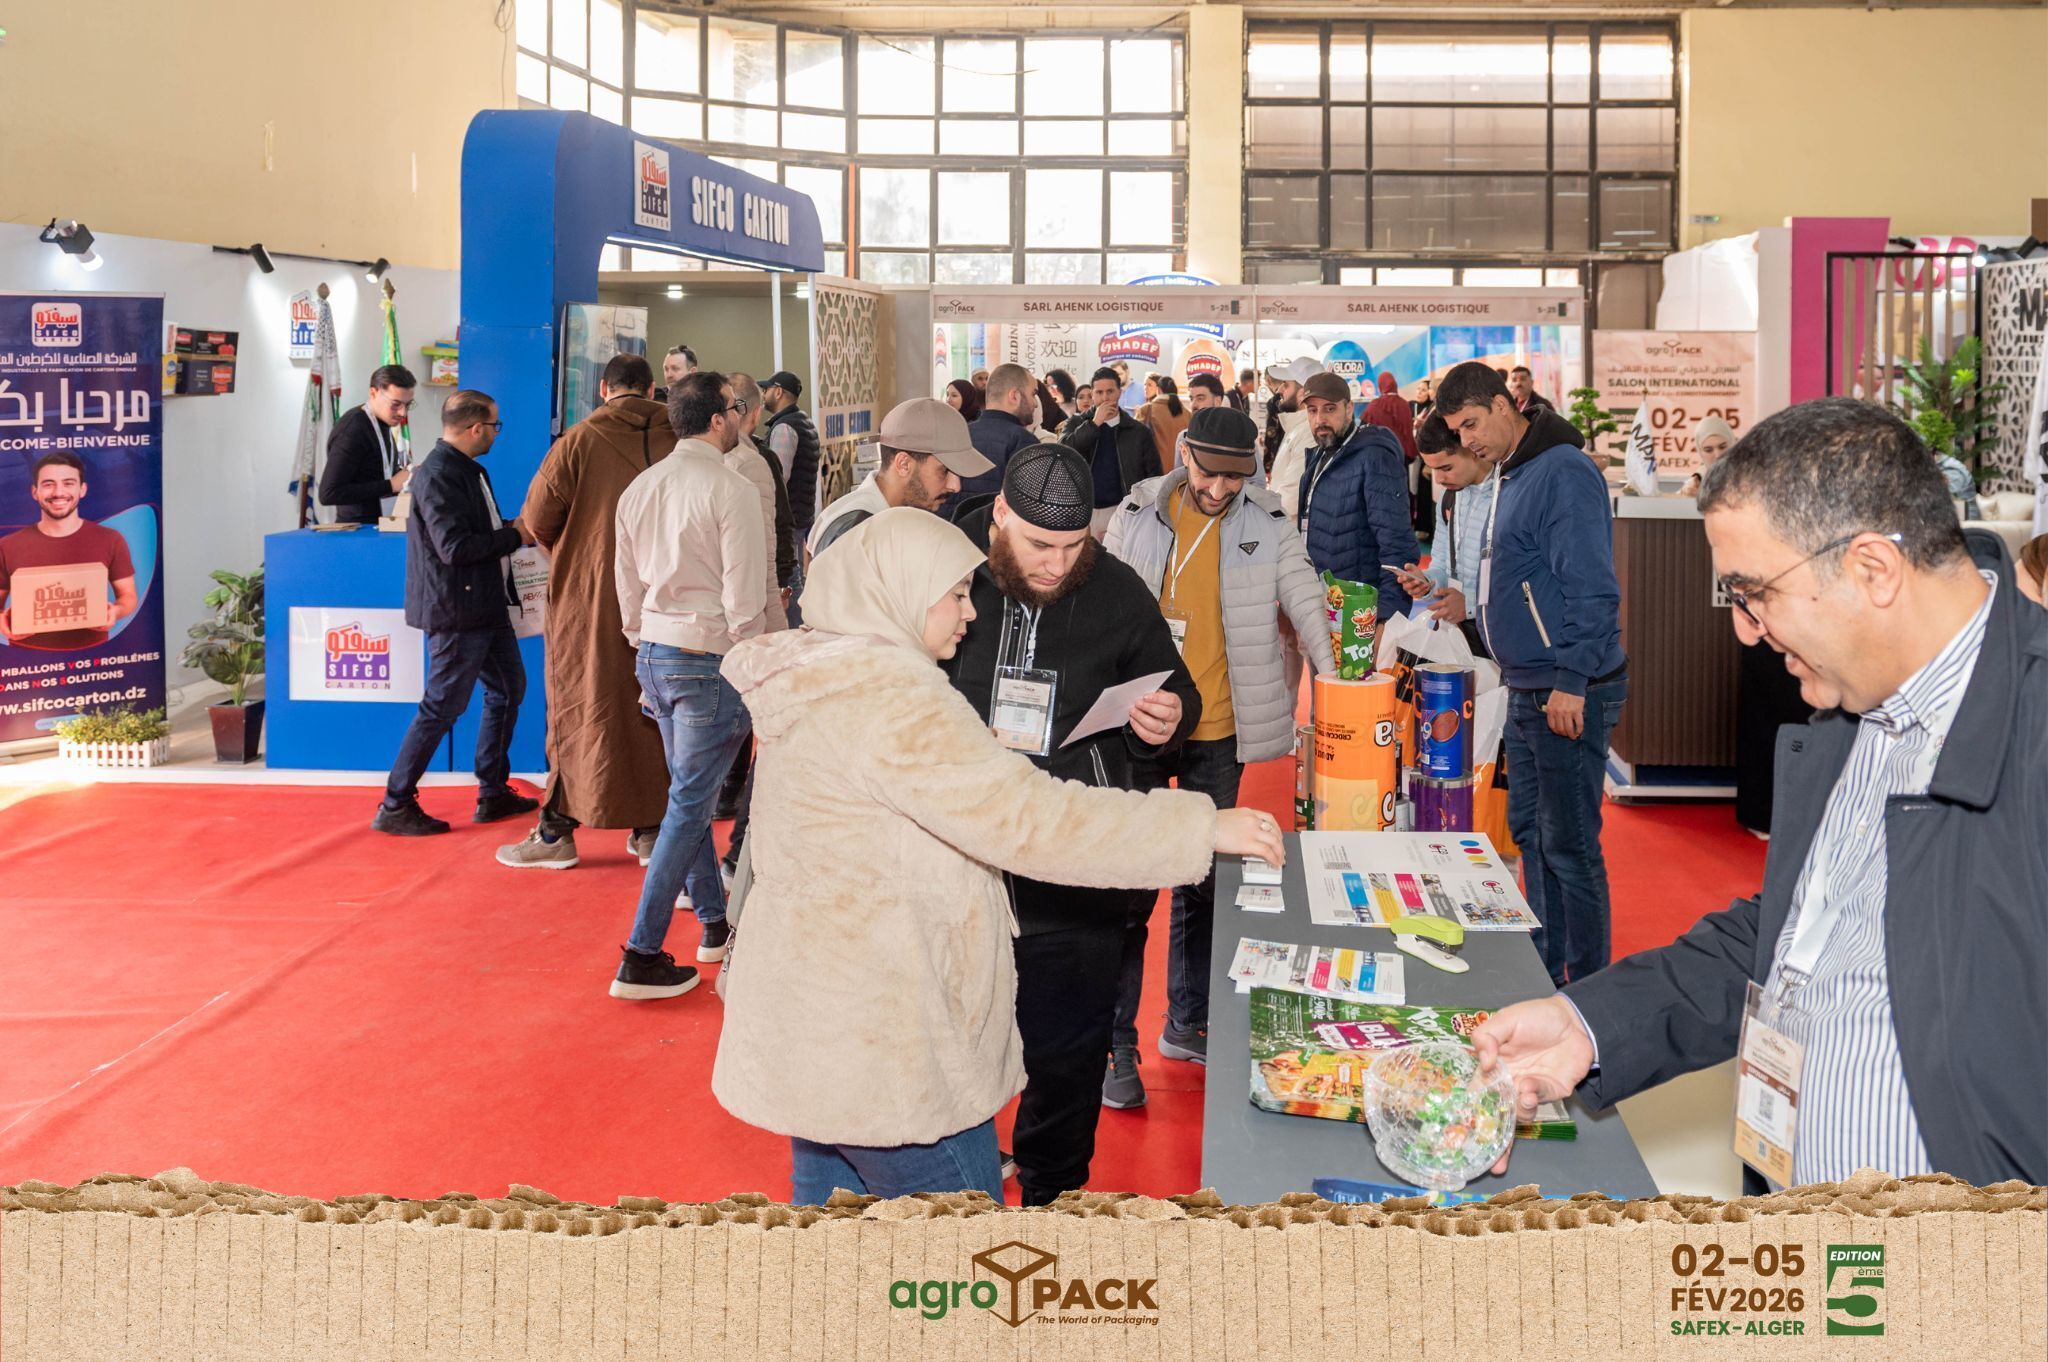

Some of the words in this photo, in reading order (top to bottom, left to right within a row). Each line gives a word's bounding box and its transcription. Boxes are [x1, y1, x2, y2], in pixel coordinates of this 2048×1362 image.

[642, 194, 668, 216] SIFCO
[691, 175, 734, 233] SIFCO
[743, 192, 790, 246] CARTON
[1023, 302, 1050, 311] SARL
[1054, 302, 1093, 311] AHENK
[1097, 302, 1164, 312] LOGISTIQUE
[1347, 303, 1375, 312] SARL
[1379, 303, 1418, 312] AHENK
[1422, 304, 1490, 313] LOGISTIQUE
[1041, 340, 1077, 358] 欢迎
[1112, 340, 1159, 353] HADEF
[62, 352, 102, 366] الصناعية
[104, 352, 138, 366] الشركة
[1607, 378, 1646, 387] SALON
[1649, 378, 1740, 388] INTERNATIONAL
[61, 378, 150, 432] مرحبا
[1651, 408, 1740, 430] 02-5
[35, 608, 86, 619] SIFCO
[0, 662, 65, 678] MBALLONS
[67, 660, 91, 670] VOS
[329, 663, 389, 677] SIFCO
[32, 677, 58, 688] NOS
[60, 669, 124, 686] SOLUTIONS
[325, 681, 391, 689] CARTON
